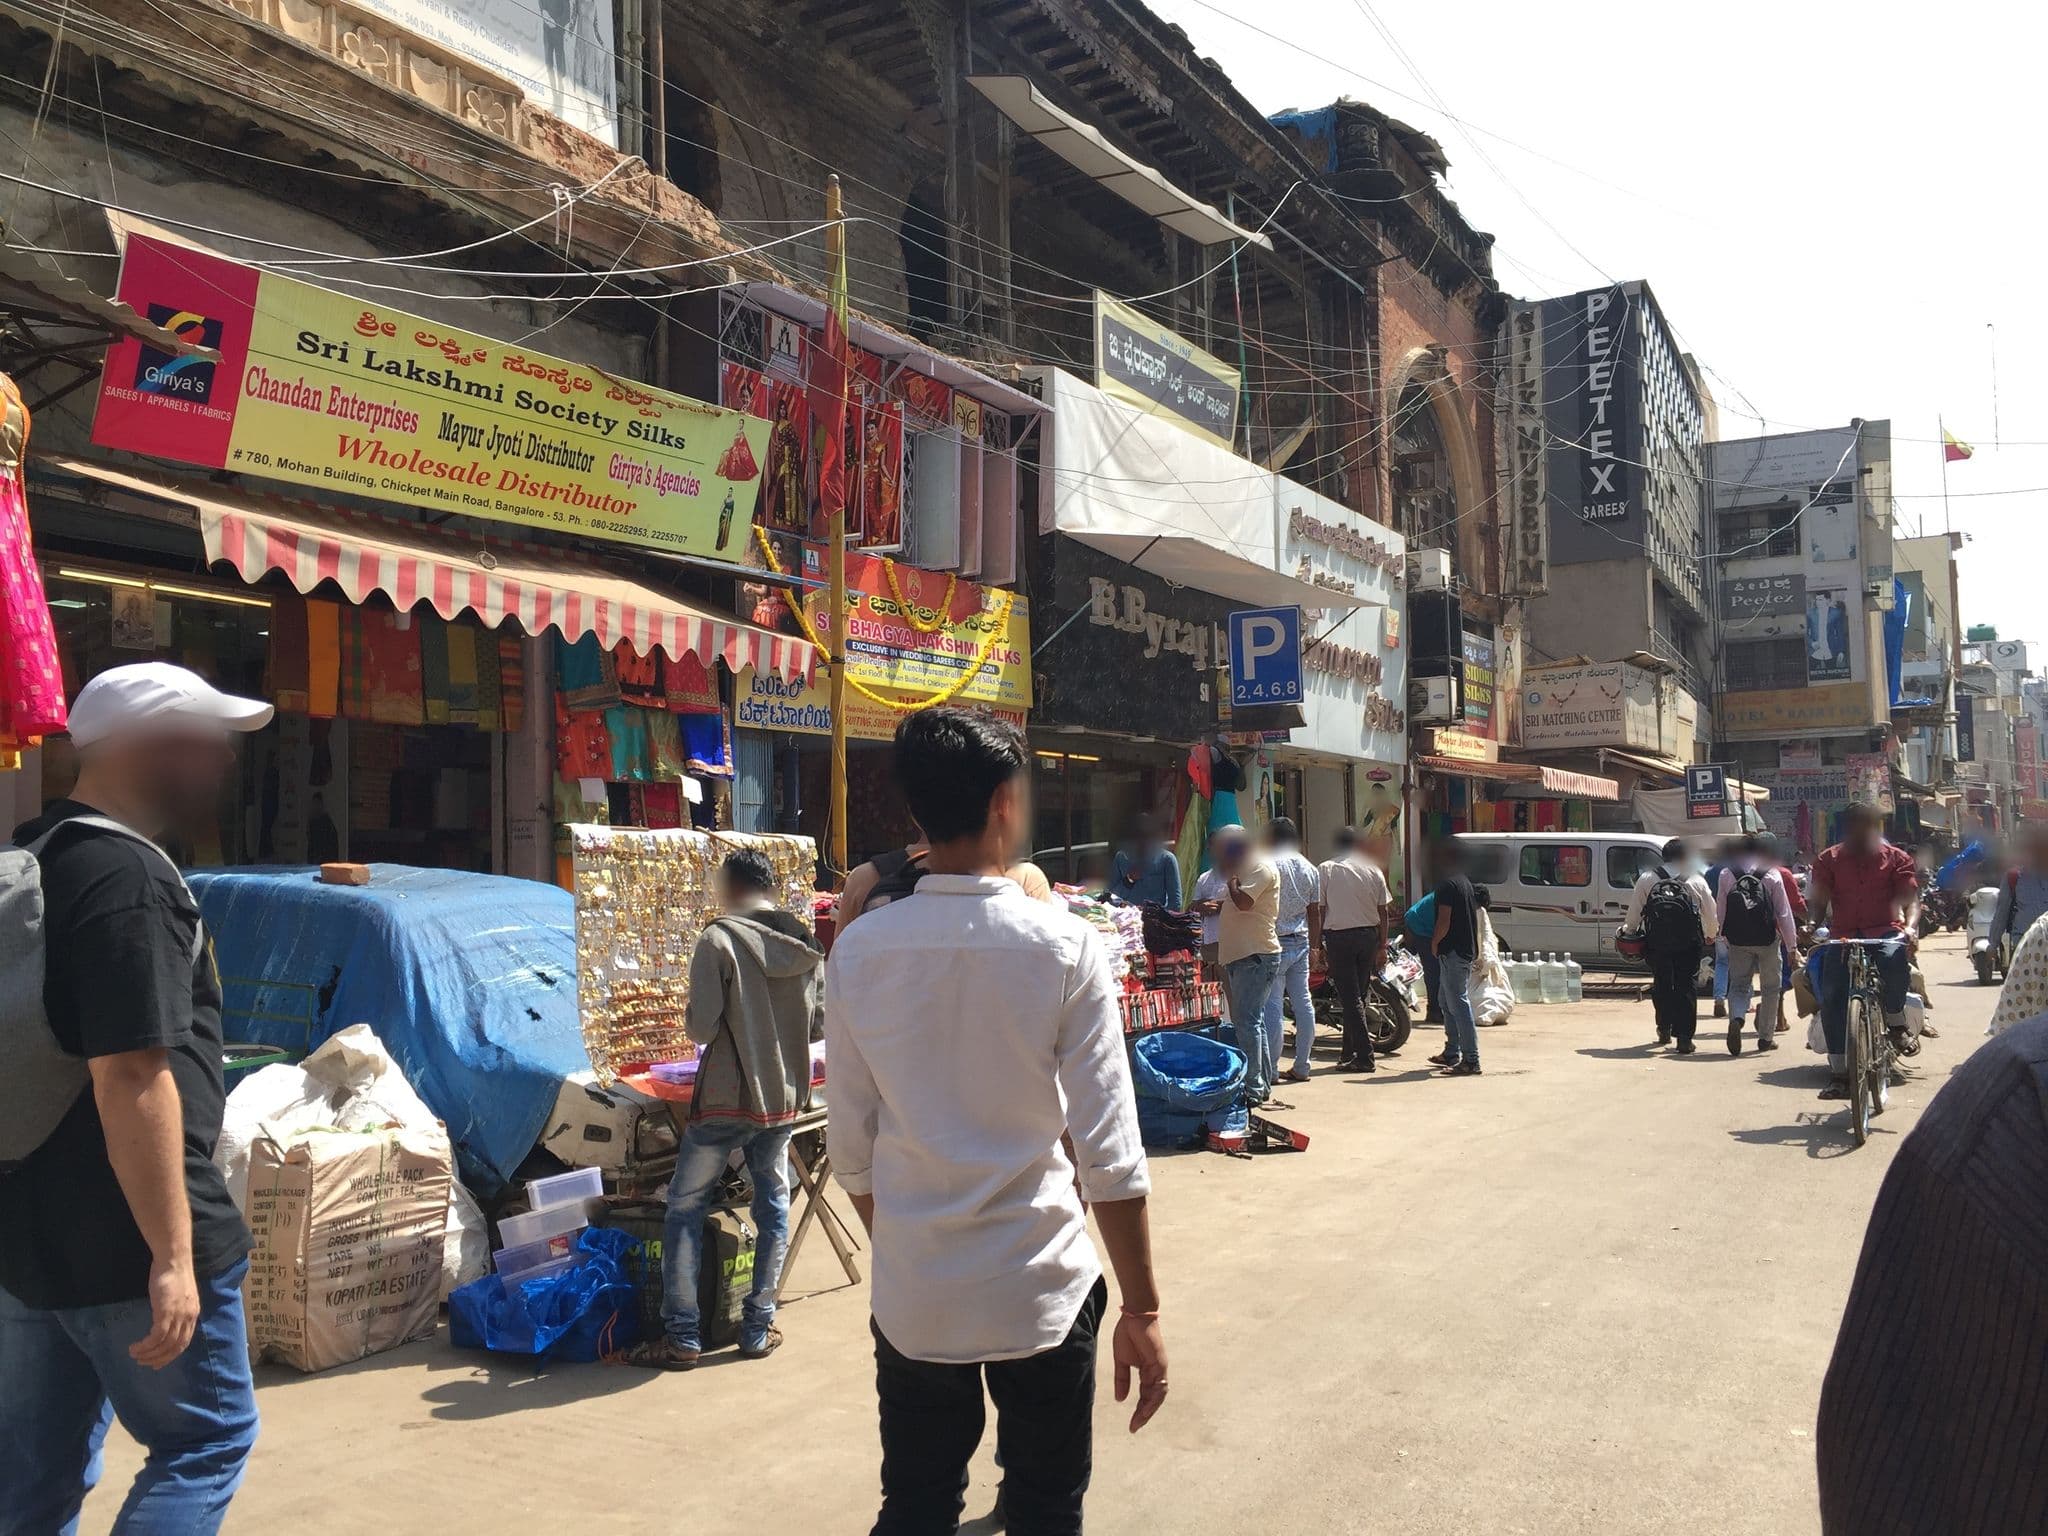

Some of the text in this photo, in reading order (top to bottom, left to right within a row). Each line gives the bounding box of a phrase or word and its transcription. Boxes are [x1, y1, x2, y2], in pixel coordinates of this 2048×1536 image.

[452, 11, 480, 36] Ready
[353, 311, 397, 338] ಶ್ರೀ
[145, 366, 205, 393] Giriya's
[296, 331, 687, 450] Sri Lakshmi Society Silks
[105, 386, 232, 422] SAREES APPARELS FABRICS
[245, 365, 419, 434] Chandan Enterprises
[1587, 293, 1616, 496] PEETEX
[437, 412, 596, 474] Mayur Jyoti Distributor
[246, 451, 272, 468] 780,
[277, 457, 320, 476] Mohan
[323, 466, 377, 488] Building,
[381, 478, 431, 497] Chickpet
[434, 488, 459, 502] Main
[462, 494, 493, 510] Road,
[494, 500, 544, 519] Bangalore
[338, 434, 638, 516] Wholesale Distributor
[608, 452, 702, 497] Giriya's Agencies
[1583, 501, 1625, 519] SAREES
[849, 619, 914, 648] BHAGYA
[916, 633, 979, 657] LAKSHMI
[1242, 616, 1285, 680] P
[852, 641, 889, 655] EXCLUSIVE
[890, 647, 898, 657] IN
[900, 650, 932, 663] WEDDING
[933, 656, 956, 667] SAREES
[1465, 663, 1493, 686] SIDDHI
[1465, 684, 1492, 704] SILKS
[1525, 708, 1622, 727] SRI MATCHING CENTRE
[1696, 770, 1713, 790] P
[404, 1168, 424, 1181] PACK
[328, 1232, 360, 1248] GROSS
[327, 1250, 353, 1265] TARE
[328, 1265, 353, 1279] NETT
[366, 1280, 387, 1297] TEA
[389, 1269, 427, 1294] ESTATE
